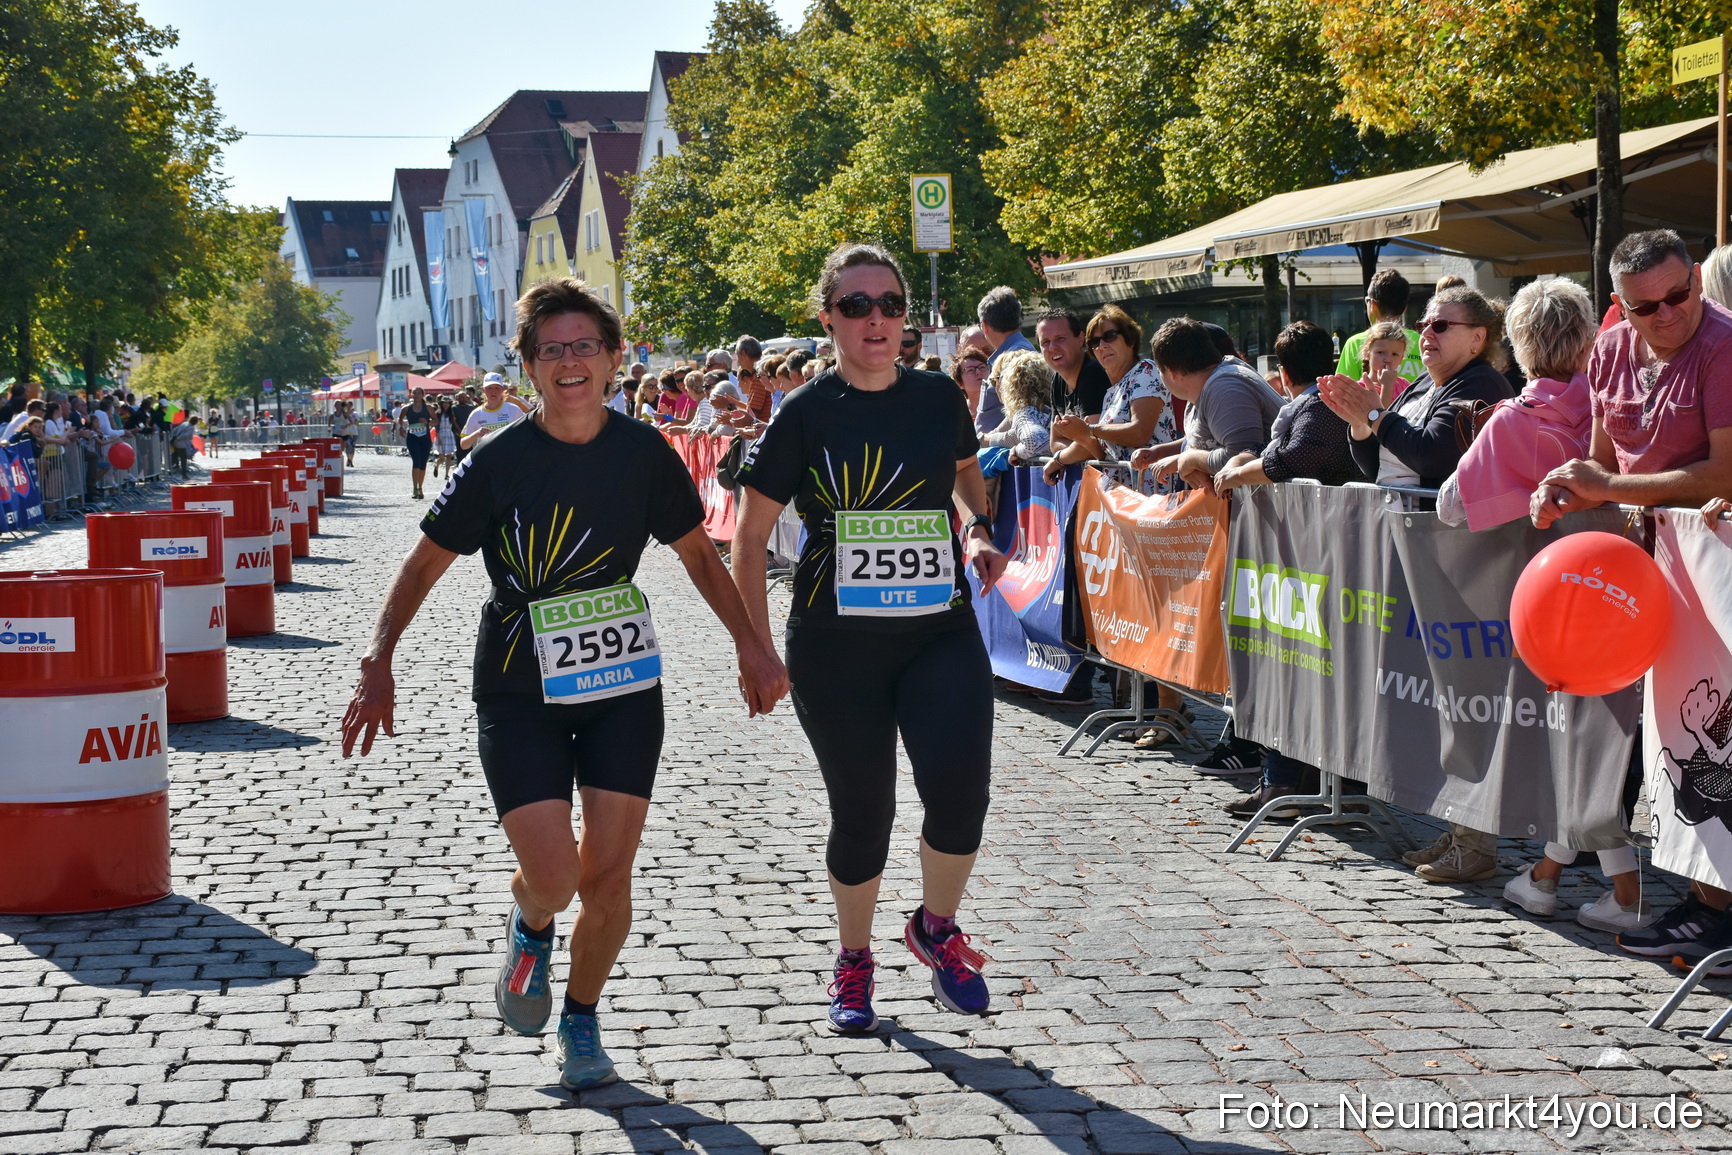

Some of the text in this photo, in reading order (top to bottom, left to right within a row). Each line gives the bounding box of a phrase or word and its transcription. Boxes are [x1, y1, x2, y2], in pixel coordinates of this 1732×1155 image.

[1681, 51, 1720, 72] Toiletten
[846, 515, 942, 538] BOCK
[1188, 514, 1214, 527] Partner
[1181, 533, 1193, 544] und
[851, 547, 941, 580] 2593
[541, 587, 638, 629] BOCK
[880, 590, 917, 605] UTE
[1232, 565, 1324, 641] BOCK
[1602, 595, 1637, 619] energie
[18, 642, 56, 652] energie
[552, 622, 645, 669] 2592
[575, 666, 635, 691] MARIA
